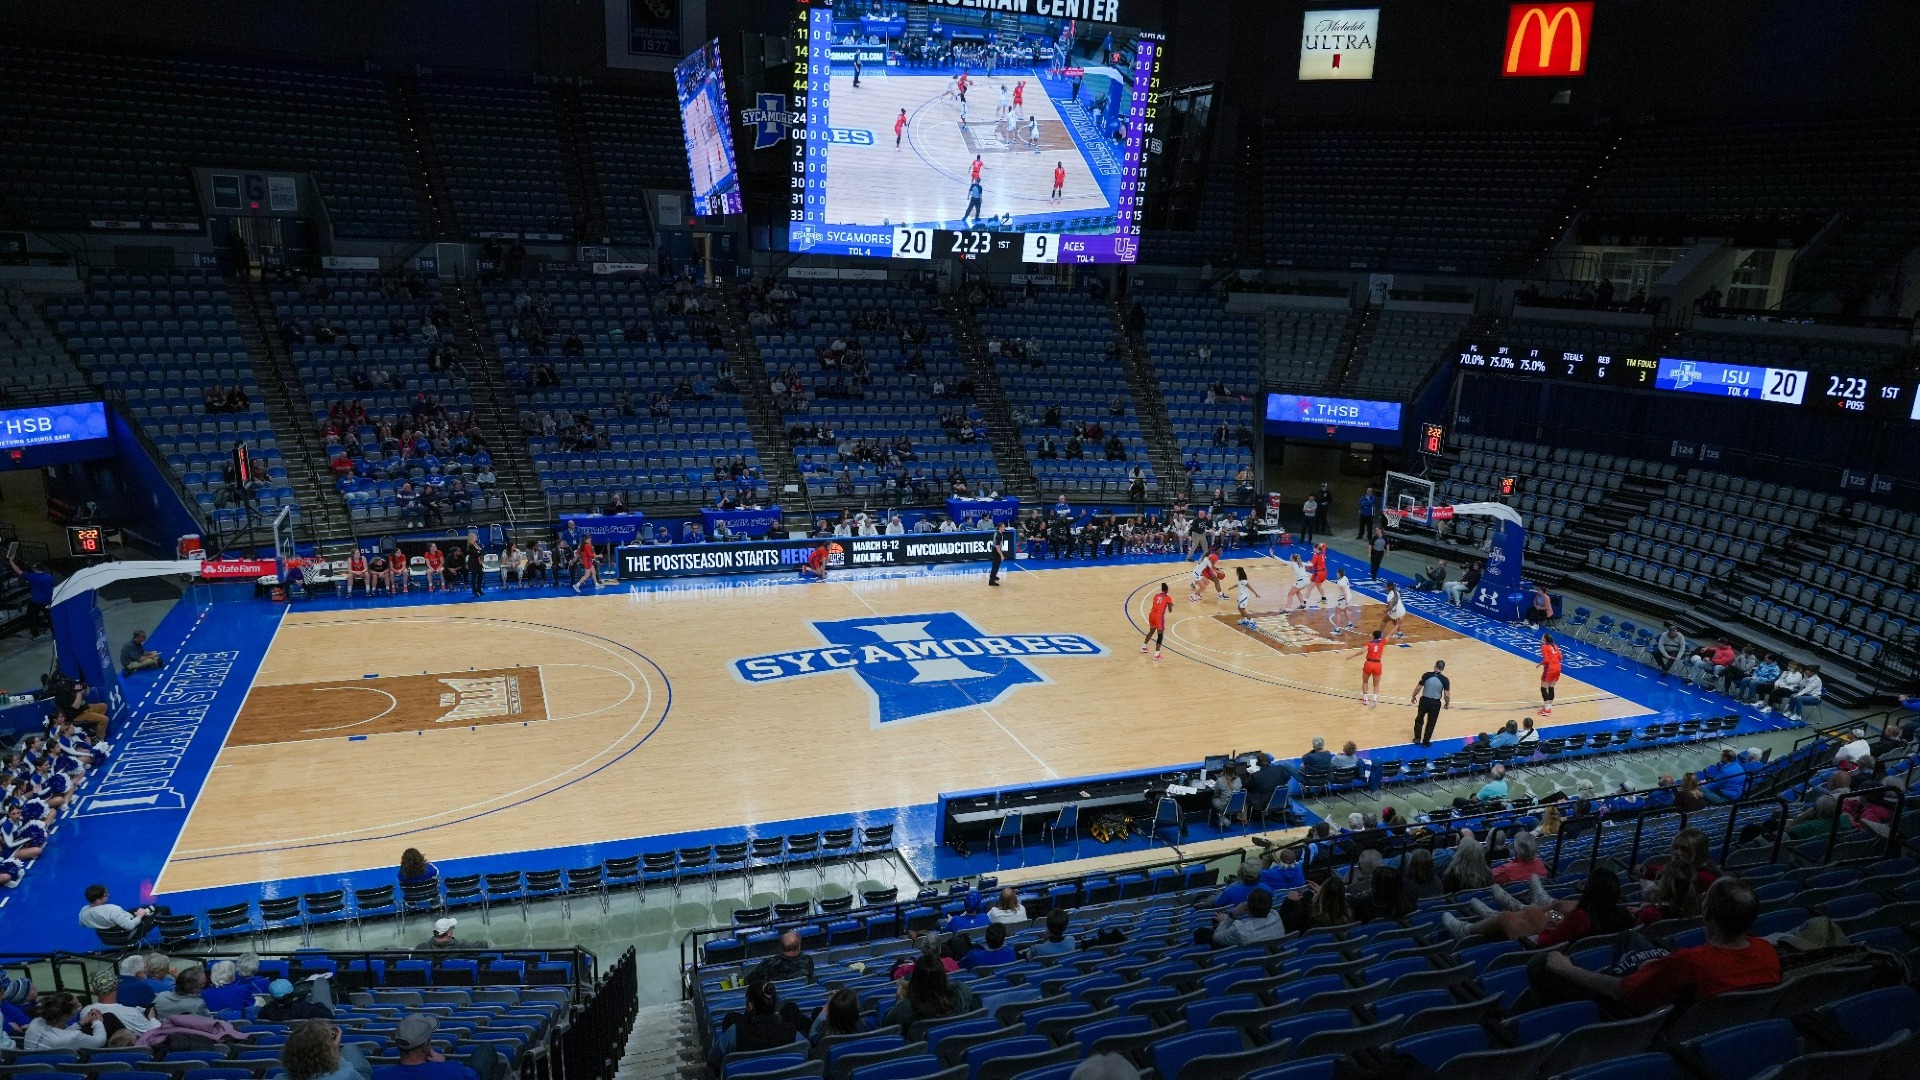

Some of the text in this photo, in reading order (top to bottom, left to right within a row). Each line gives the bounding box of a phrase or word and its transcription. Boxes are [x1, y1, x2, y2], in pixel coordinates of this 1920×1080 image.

[1037, 0, 1118, 22] CENTER
[799, 11, 830, 23] 4 2 1
[1315, 20, 1366, 32] Michelob
[797, 29, 820, 39] 11 0
[1306, 34, 1372, 50] ULTRA
[795, 46, 808, 57] 14
[813, 48, 819, 57] 2
[1147, 46, 1162, 57] 0 0
[794, 63, 818, 74] 23 6
[1145, 62, 1159, 72] 0 3
[793, 80, 818, 91] 44 2
[1136, 77, 1139, 85] 1
[1150, 78, 1160, 88] 21
[794, 96, 817, 107] 51 5
[1141, 93, 1158, 103] 0 22
[742, 111, 793, 124] SYCAMORE
[792, 113, 828, 124] 24 3 1
[1139, 108, 1156, 118] 0 32
[1130, 122, 1133, 130] 1
[1144, 123, 1153, 133] 14
[792, 129, 816, 140] 00 0
[1135, 138, 1148, 148] 3 1
[796, 146, 816, 156] 2 0
[1133, 153, 1147, 162] 0 5
[793, 161, 815, 172] 13 0
[1132, 168, 1147, 177] 0 11
[791, 178, 814, 188] 30 0
[1130, 182, 1145, 191] 0 12
[792, 194, 814, 204] 31 0
[1136, 197, 1144, 206] 13
[791, 210, 824, 221] 33 0 1
[1126, 211, 1142, 220] 0 15
[1124, 226, 1140, 235] 0 25
[827, 232, 891, 244] SYCAMORES
[900, 230, 926, 254] 20
[951, 231, 991, 253] 2:23
[998, 241, 1010, 249] 1ST
[1036, 236, 1046, 258] 9
[1063, 242, 1085, 252] ACES
[849, 248, 870, 256] TOL 4
[202, 256, 216, 264] 114
[1460, 354, 1485, 366] 70.0%
[1490, 357, 1514, 369] 75.0%
[1563, 353, 1583, 362] STEALS
[1598, 356, 1610, 364] REB
[1520, 360, 1545, 372] 75.0%
[1568, 364, 1574, 374] 2
[1626, 359, 1656, 368] TM FOULS
[1598, 368, 1605, 377] 6
[1639, 371, 1646, 381] 3
[1722, 369, 1749, 384] ISU
[1770, 371, 1797, 397] 20
[1827, 376, 1867, 398] 2:23
[1727, 386, 1749, 397] TOL 4
[1881, 386, 1900, 398] 1ST
[1318, 404, 1359, 417] THSB
[1846, 400, 1864, 410] POSS
[26, 435, 52, 444] SAVINGS
[83, 539, 96, 550] 18
[852, 540, 899, 551] MARCH 9-12
[907, 540, 1009, 557] MVCQUADCITIES.CM
[626, 556, 650, 572] THE
[654, 552, 732, 571] POSTSEASON
[735, 550, 779, 567] STARTS
[853, 553, 886, 563] MOLINE,
[887, 552, 894, 562] IL
[744, 635, 1094, 679] SYCAMORES
